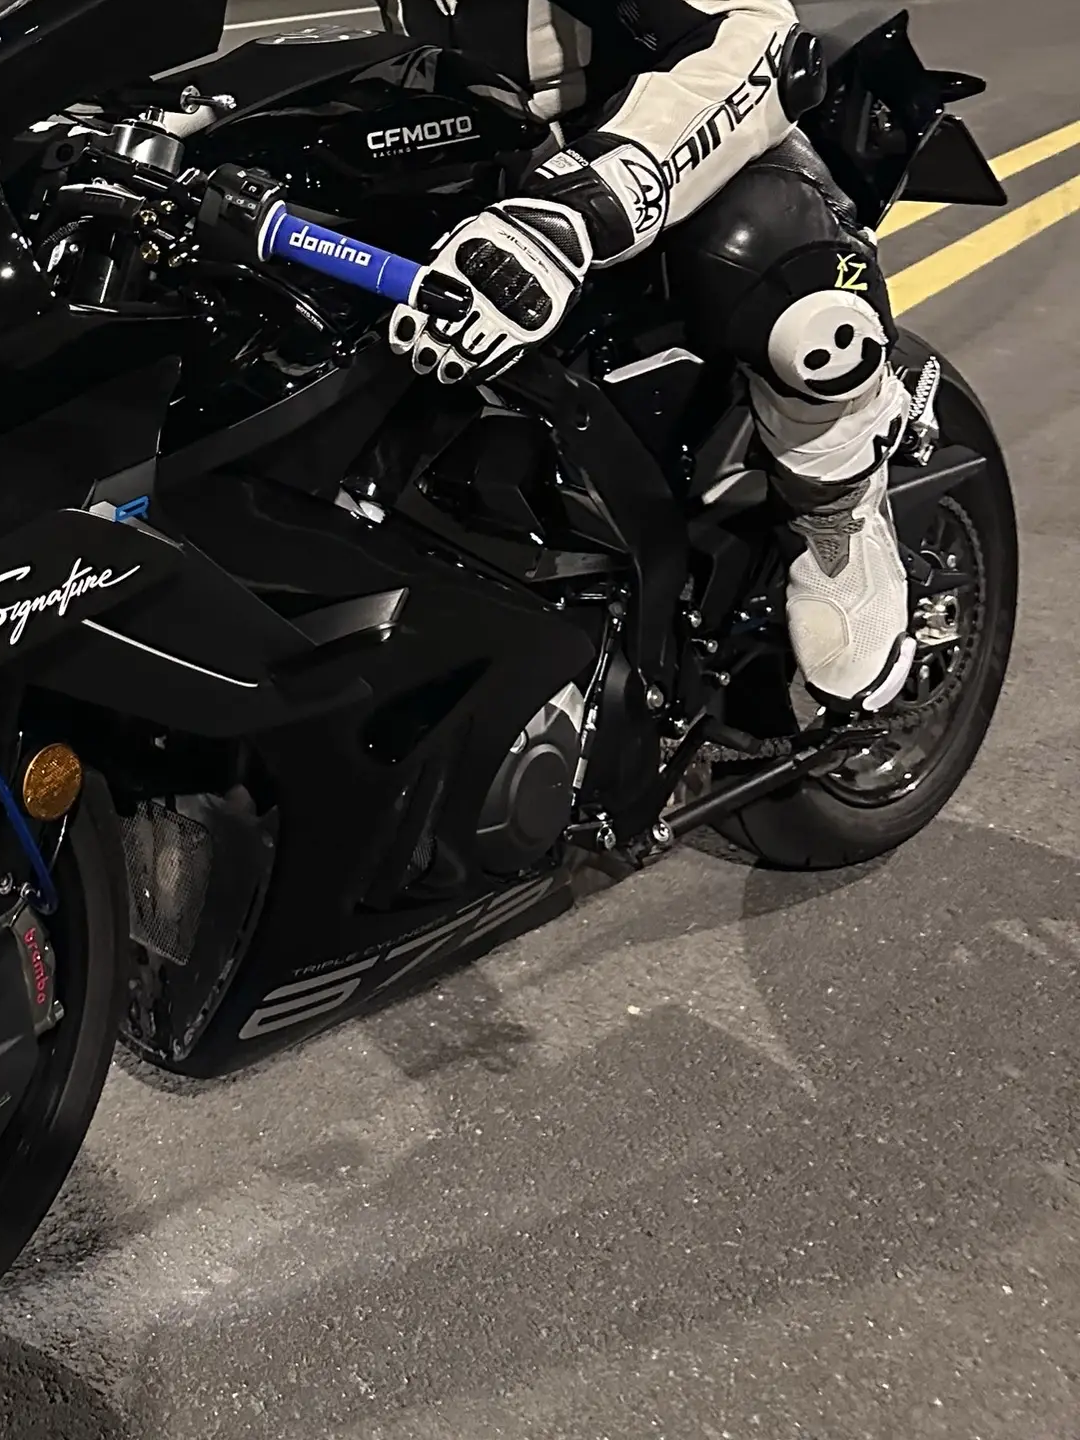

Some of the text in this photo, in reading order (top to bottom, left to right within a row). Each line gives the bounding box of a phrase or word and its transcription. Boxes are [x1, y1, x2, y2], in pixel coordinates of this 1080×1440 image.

[366, 116, 472, 150] CFMOTO
[289, 225, 372, 266] domino
[24, 927, 48, 1005] brembo
